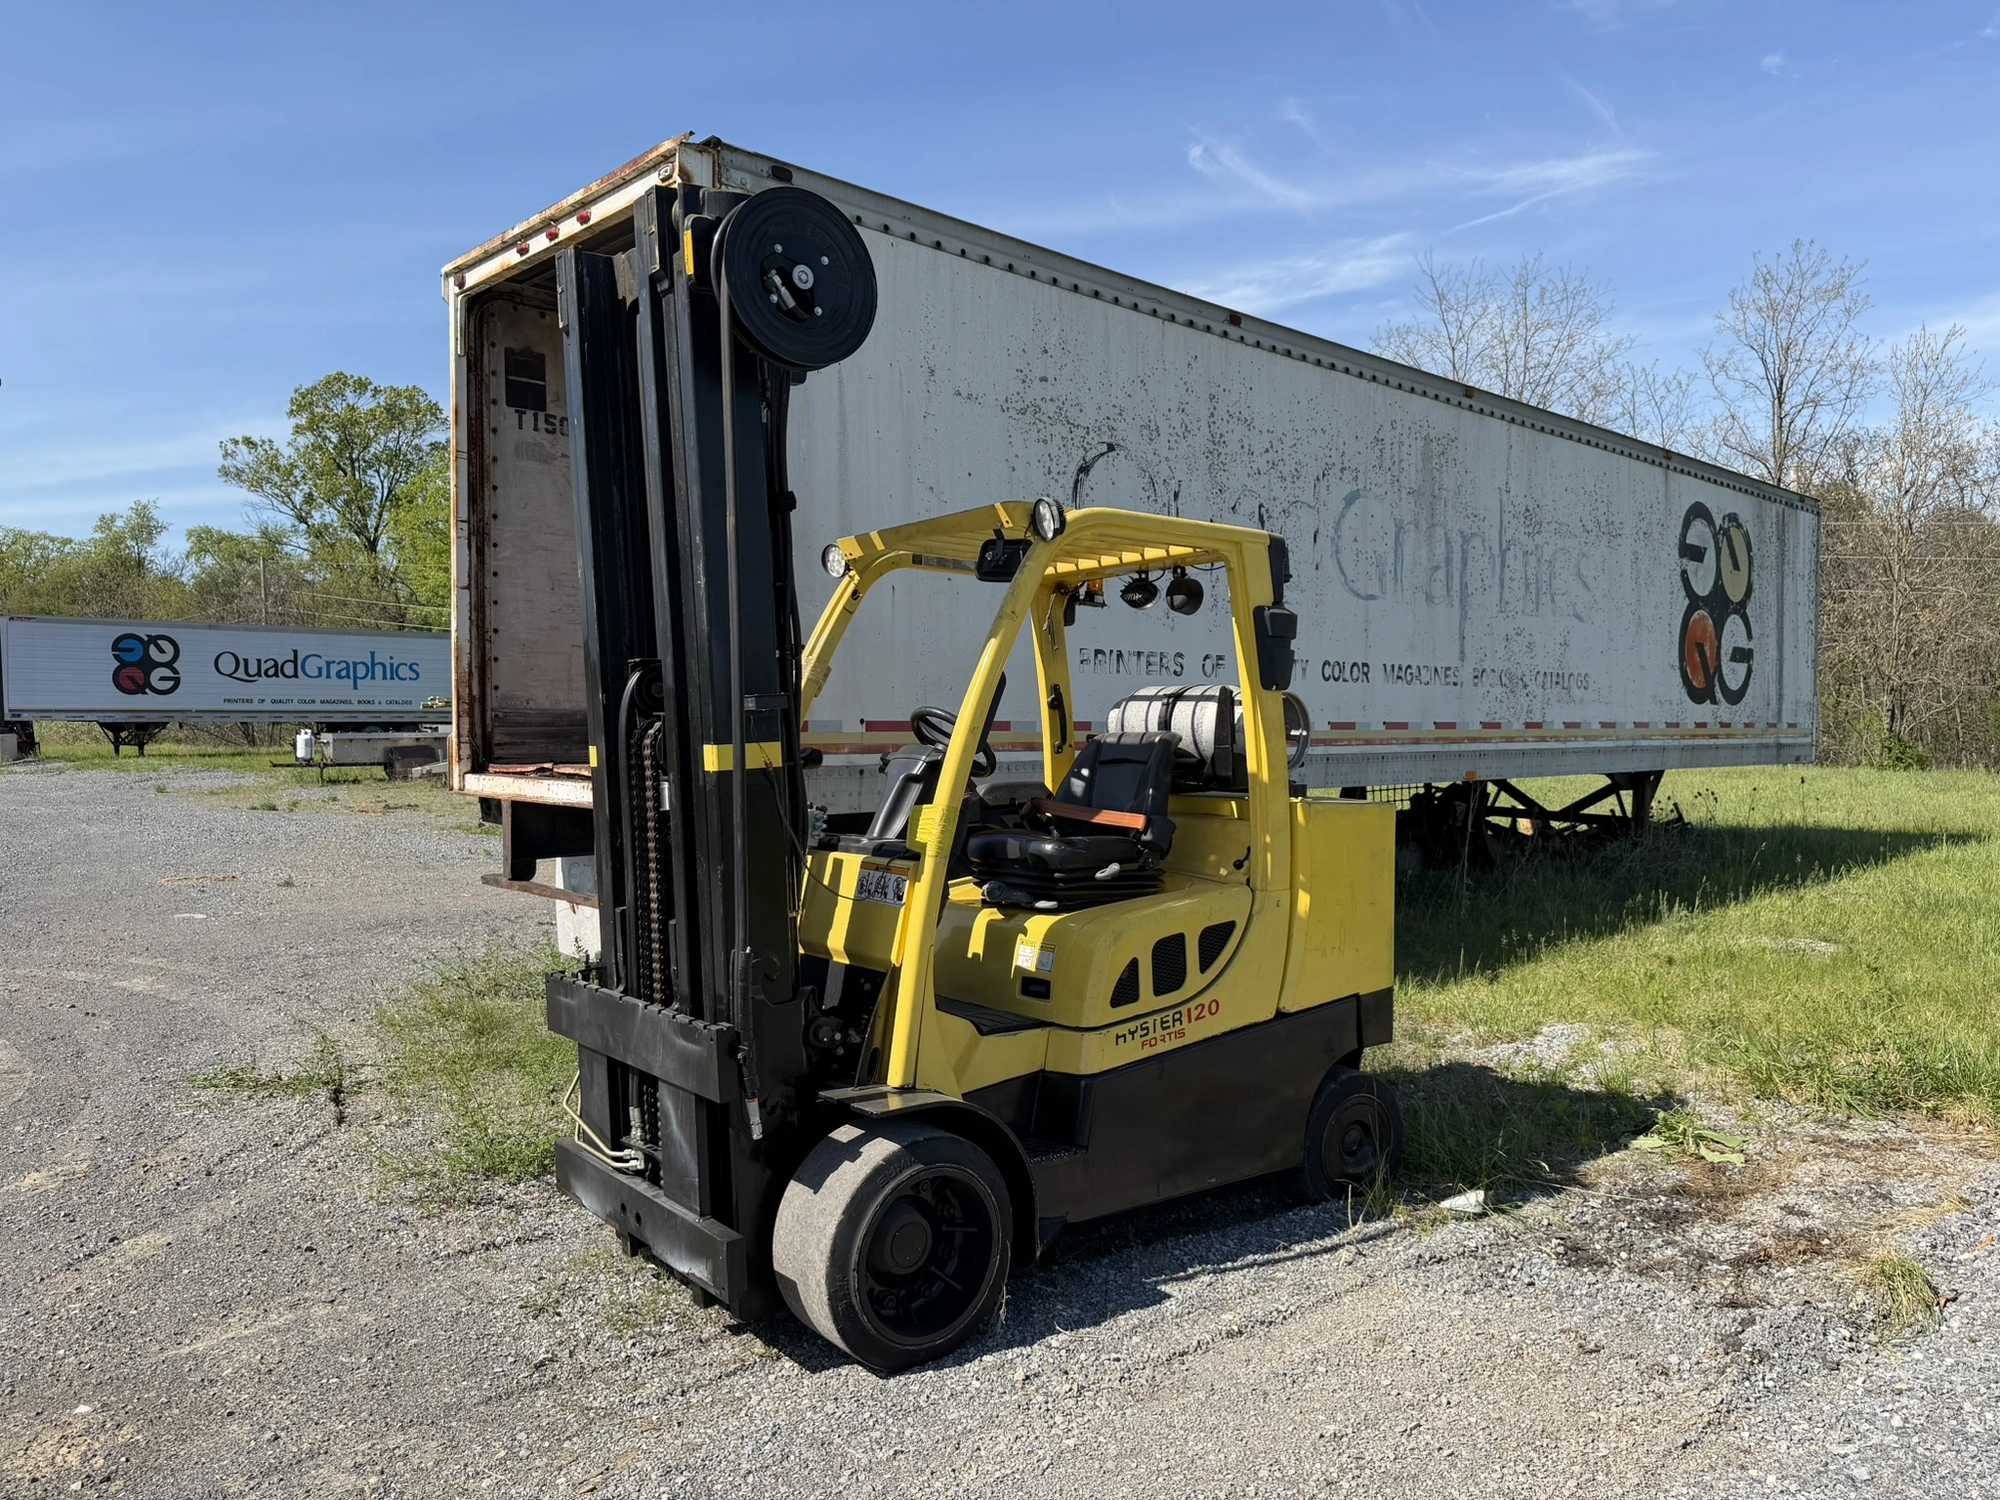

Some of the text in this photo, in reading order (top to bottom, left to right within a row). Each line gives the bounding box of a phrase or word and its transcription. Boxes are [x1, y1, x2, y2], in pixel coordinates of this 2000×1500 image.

[1078, 647, 1186, 678] PRINTERS
[1201, 653, 1227, 679] OF
[1321, 659, 1371, 684] COLOR
[222, 697, 254, 705] PRINTERS
[1115, 998, 1220, 1047] HYSTER 120
[1141, 1027, 1186, 1051] FORTIS
